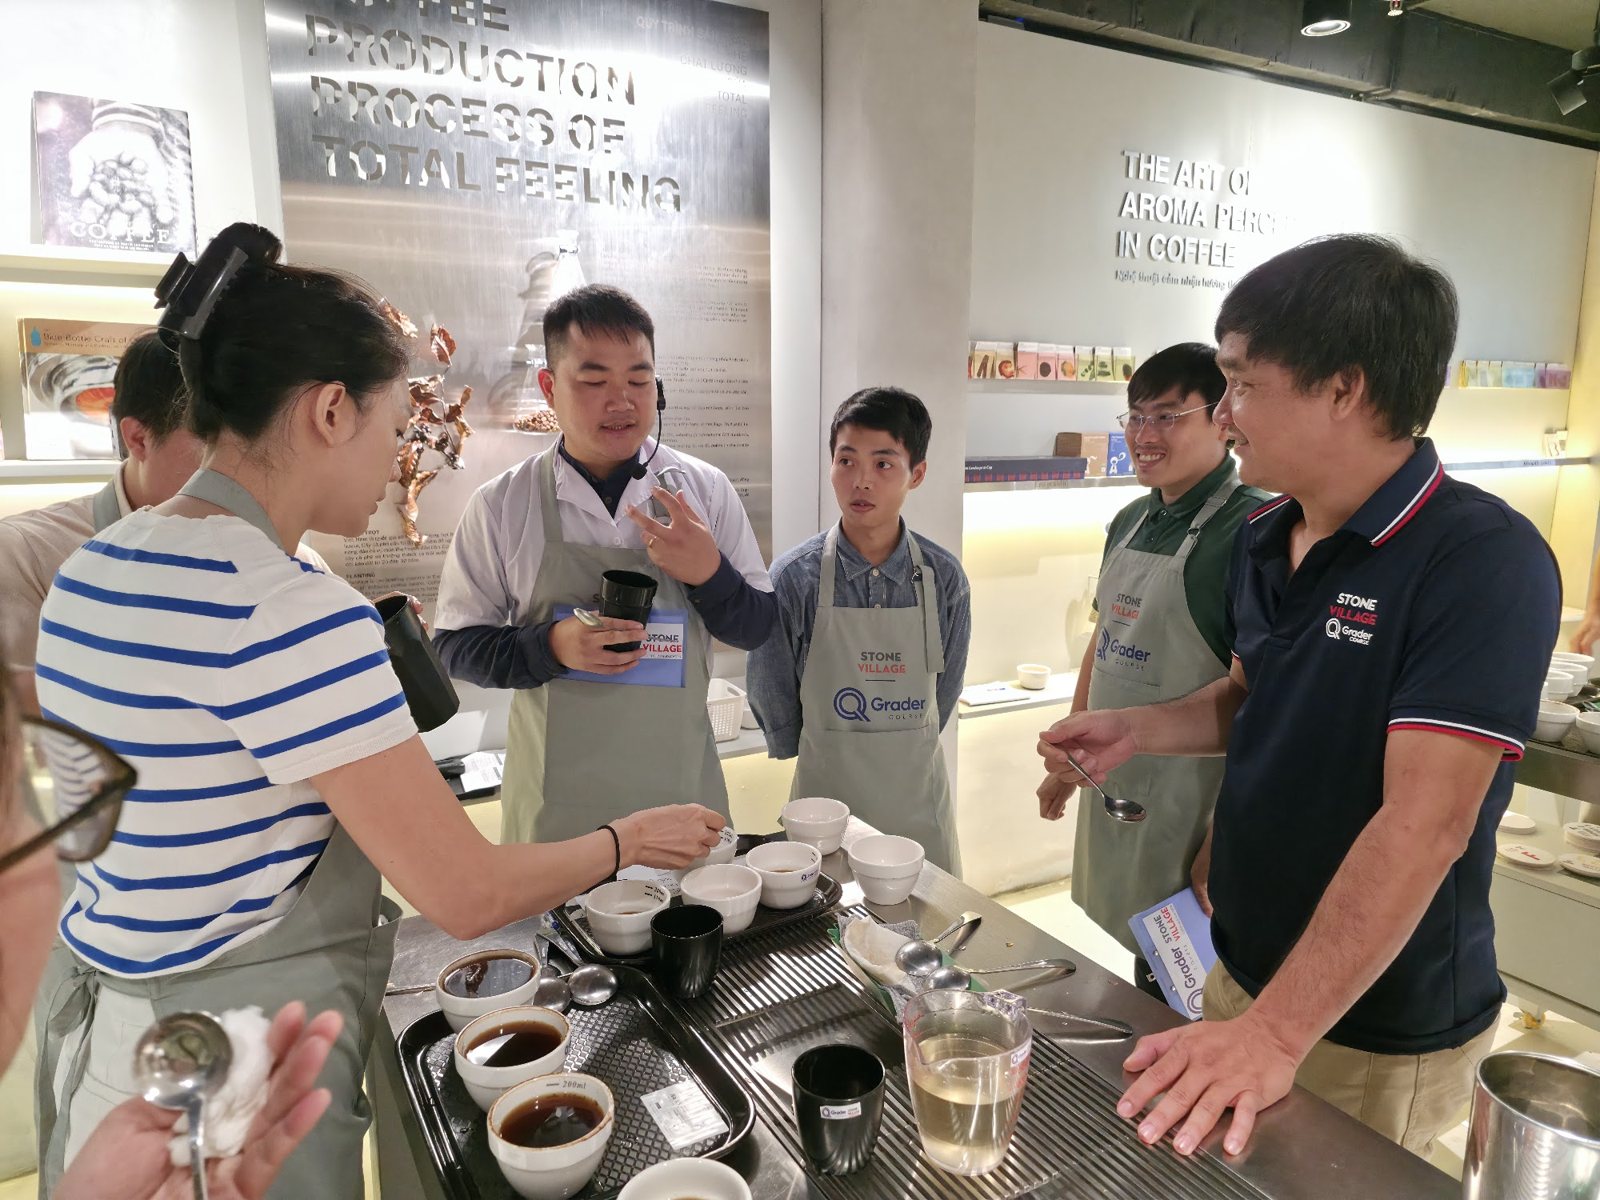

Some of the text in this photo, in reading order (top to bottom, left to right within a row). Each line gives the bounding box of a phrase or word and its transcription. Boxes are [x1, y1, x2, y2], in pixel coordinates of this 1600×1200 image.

[306, 14, 635, 105] PRODUCTION
[310, 76, 625, 153] PROCESS OF
[312, 135, 681, 212] TOTAL FEELING
[1122, 150, 1171, 184] THE
[1174, 159, 1226, 191] ART
[1118, 191, 1208, 229] AROMA
[1116, 230, 1236, 269] IN COFFEE
[1117, 594, 1142, 607] STONE
[1337, 593, 1377, 610] STONE
[1329, 605, 1377, 625] VILLAGE
[646, 634, 679, 643] STONE
[1326, 618, 1373, 640] Q Grader
[643, 644, 683, 652] VILLAGE
[861, 652, 901, 661] STONE
[1111, 639, 1150, 662] Grader
[858, 664, 905, 673] VILLAGE
[834, 687, 926, 722] Q Grader
[1154, 914, 1172, 943] STONE
[1160, 907, 1181, 941] VILLAGE
[1172, 947, 1196, 989] Grader
[563, 1080, 586, 1089] 200ml
